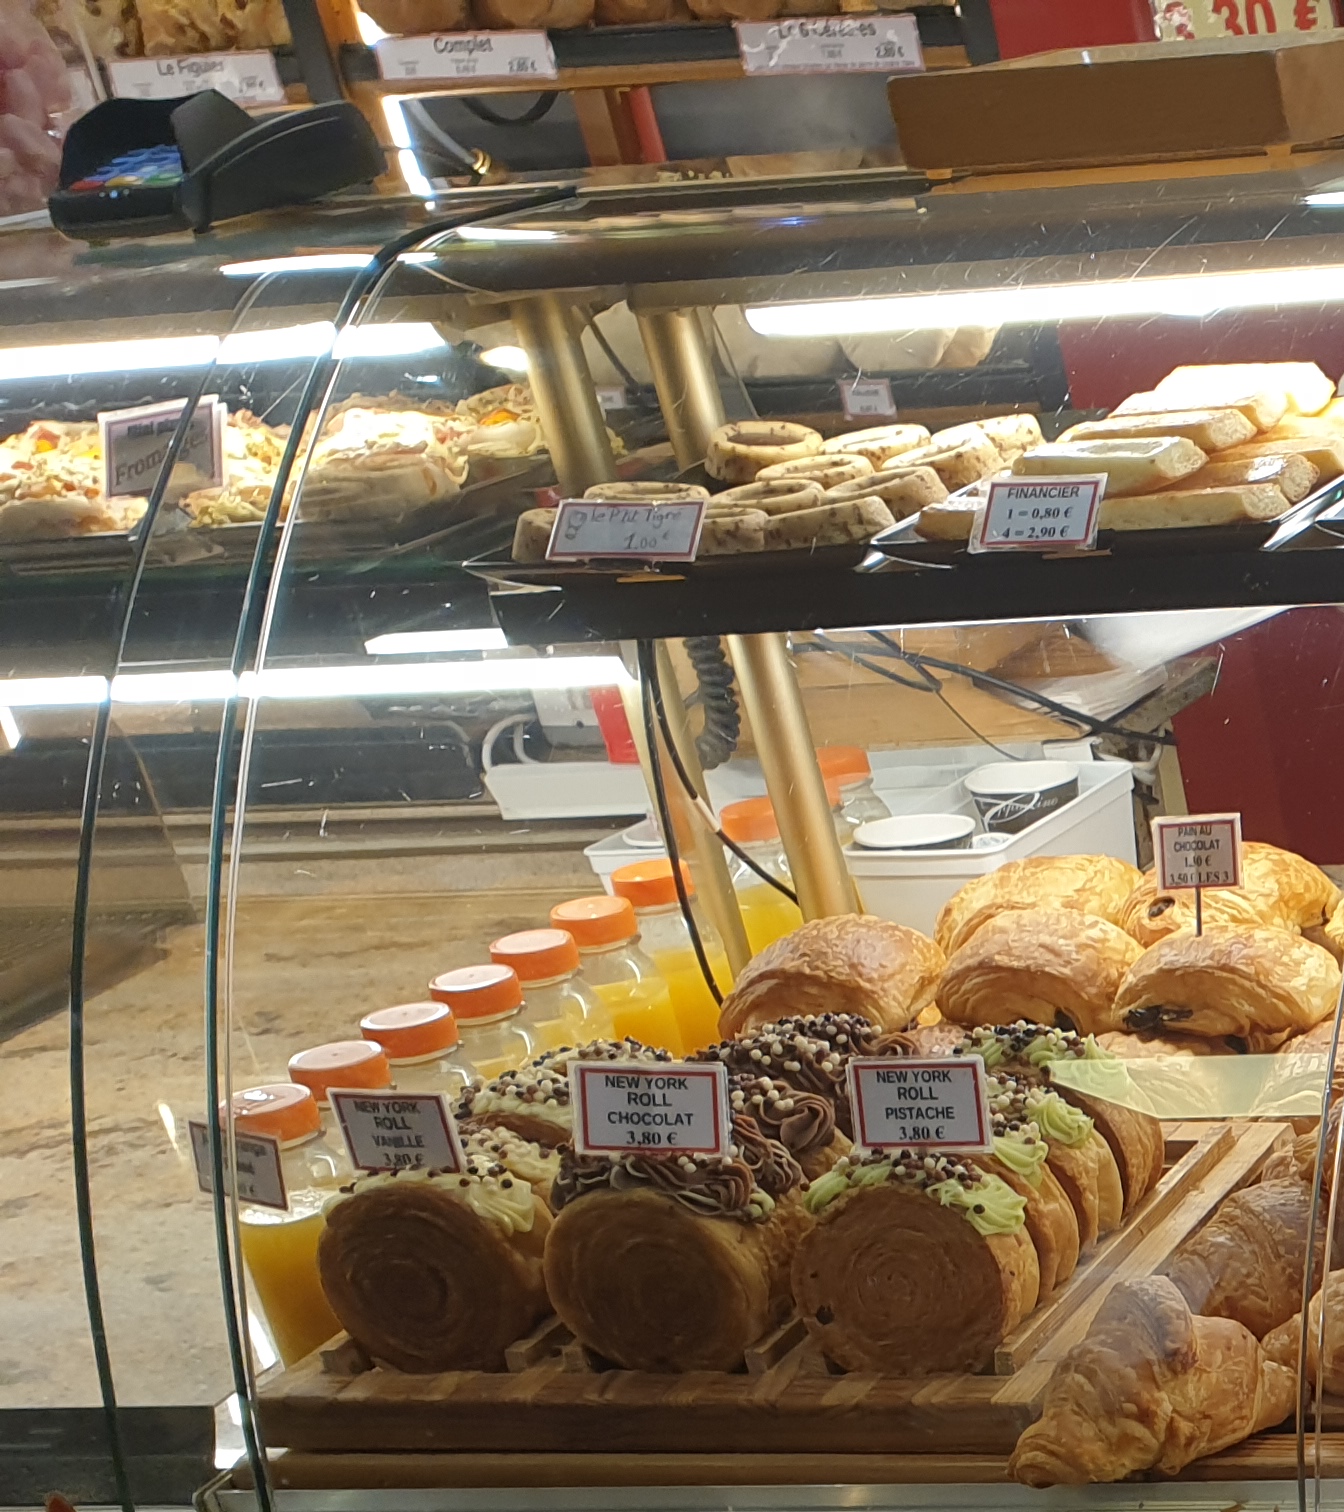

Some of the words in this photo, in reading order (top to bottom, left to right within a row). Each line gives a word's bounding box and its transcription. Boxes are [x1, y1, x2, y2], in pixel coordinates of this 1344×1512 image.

[1007, 486, 1080, 499] FINANCIER
[1008, 508, 1013, 519] 1
[1031, 507, 1060, 520] 0,80
[1064, 506, 1074, 519] €
[1002, 527, 1010, 538] 4
[1027, 526, 1056, 539] 2,90
[1060, 525, 1070, 538] €
[1178, 826, 1197, 837] PAIN
[1200, 825, 1212, 836] AU
[1173, 839, 1220, 853] CHOCOLAT
[1205, 855, 1212, 867] €
[605, 1075, 639, 1089] NEW
[645, 1077, 688, 1090] YORK
[876, 1071, 908, 1083] NEW
[912, 1070, 952, 1083] YORK
[628, 1092, 672, 1107] ROLL
[897, 1086, 939, 1101] ROLL
[353, 1100, 379, 1113] NEW
[382, 1101, 421, 1114] YORK
[885, 1106, 955, 1120] PISTACHE
[373, 1116, 411, 1130] ROLL
[607, 1111, 694, 1127] CHOCOLAT
[626, 1131, 661, 1146] 3,80
[667, 1132, 678, 1145] €
[899, 1126, 930, 1141] 3,80
[935, 1126, 945, 1139] €
